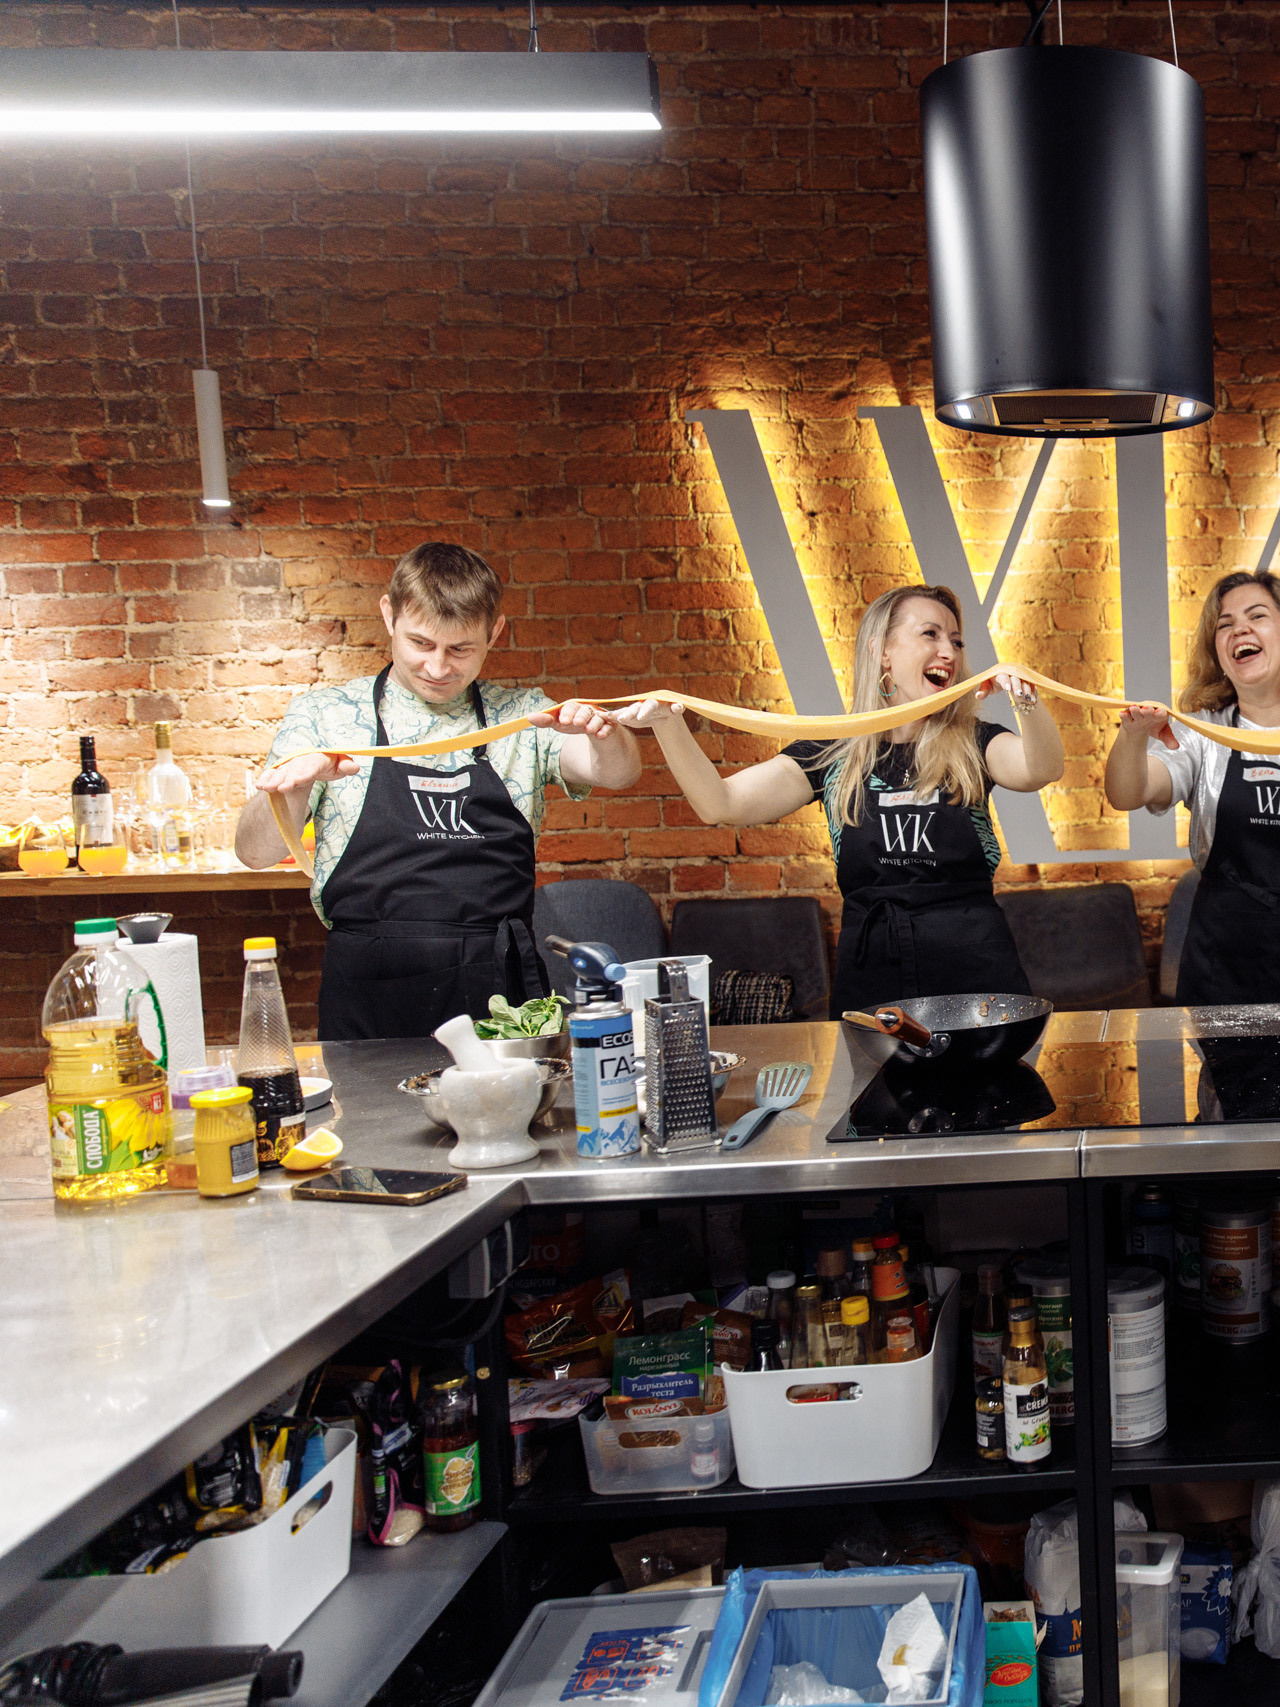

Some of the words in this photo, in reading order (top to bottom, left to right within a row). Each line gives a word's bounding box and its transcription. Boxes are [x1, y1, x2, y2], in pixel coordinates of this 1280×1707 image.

[411, 791, 480, 835] WK
[1249, 817, 1269, 826] WHITE
[417, 832, 447, 841] WHITE
[879, 811, 936, 853] WK
[878, 857, 902, 866] WHITE
[903, 858, 937, 867] KITCHEN
[628, 1351, 691, 1367] Лемонграсс
[631, 1378, 694, 1392] Разрыхлитель
[650, 1389, 675, 1398] теста
[1049, 1404, 1075, 1415] BERG
